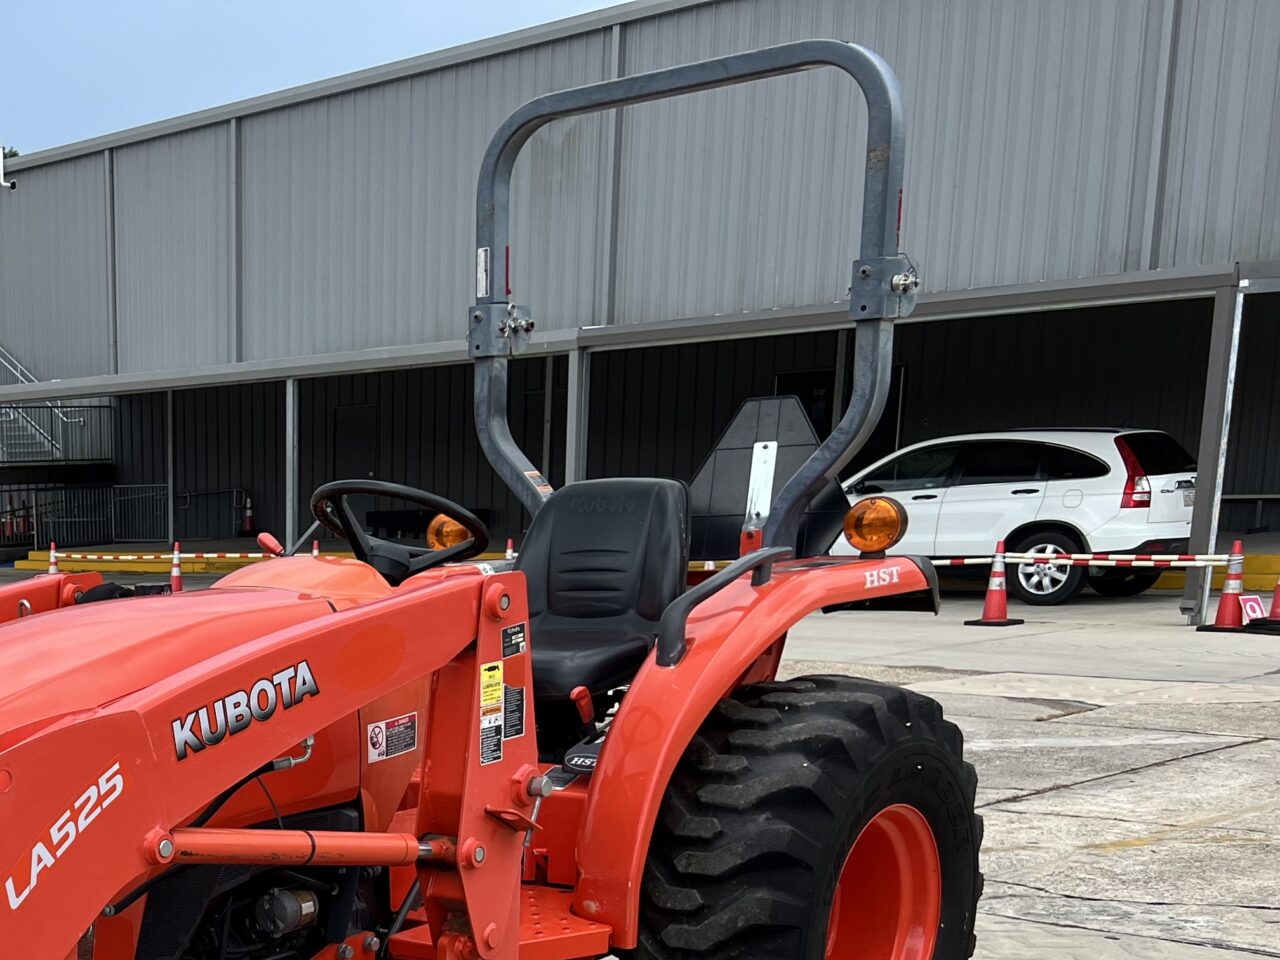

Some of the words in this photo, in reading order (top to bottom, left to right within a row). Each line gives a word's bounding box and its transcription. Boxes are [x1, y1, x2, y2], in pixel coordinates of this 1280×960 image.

[864, 566, 900, 589] HST
[172, 660, 319, 761] KUBOTA
[5, 761, 124, 910] LA525
